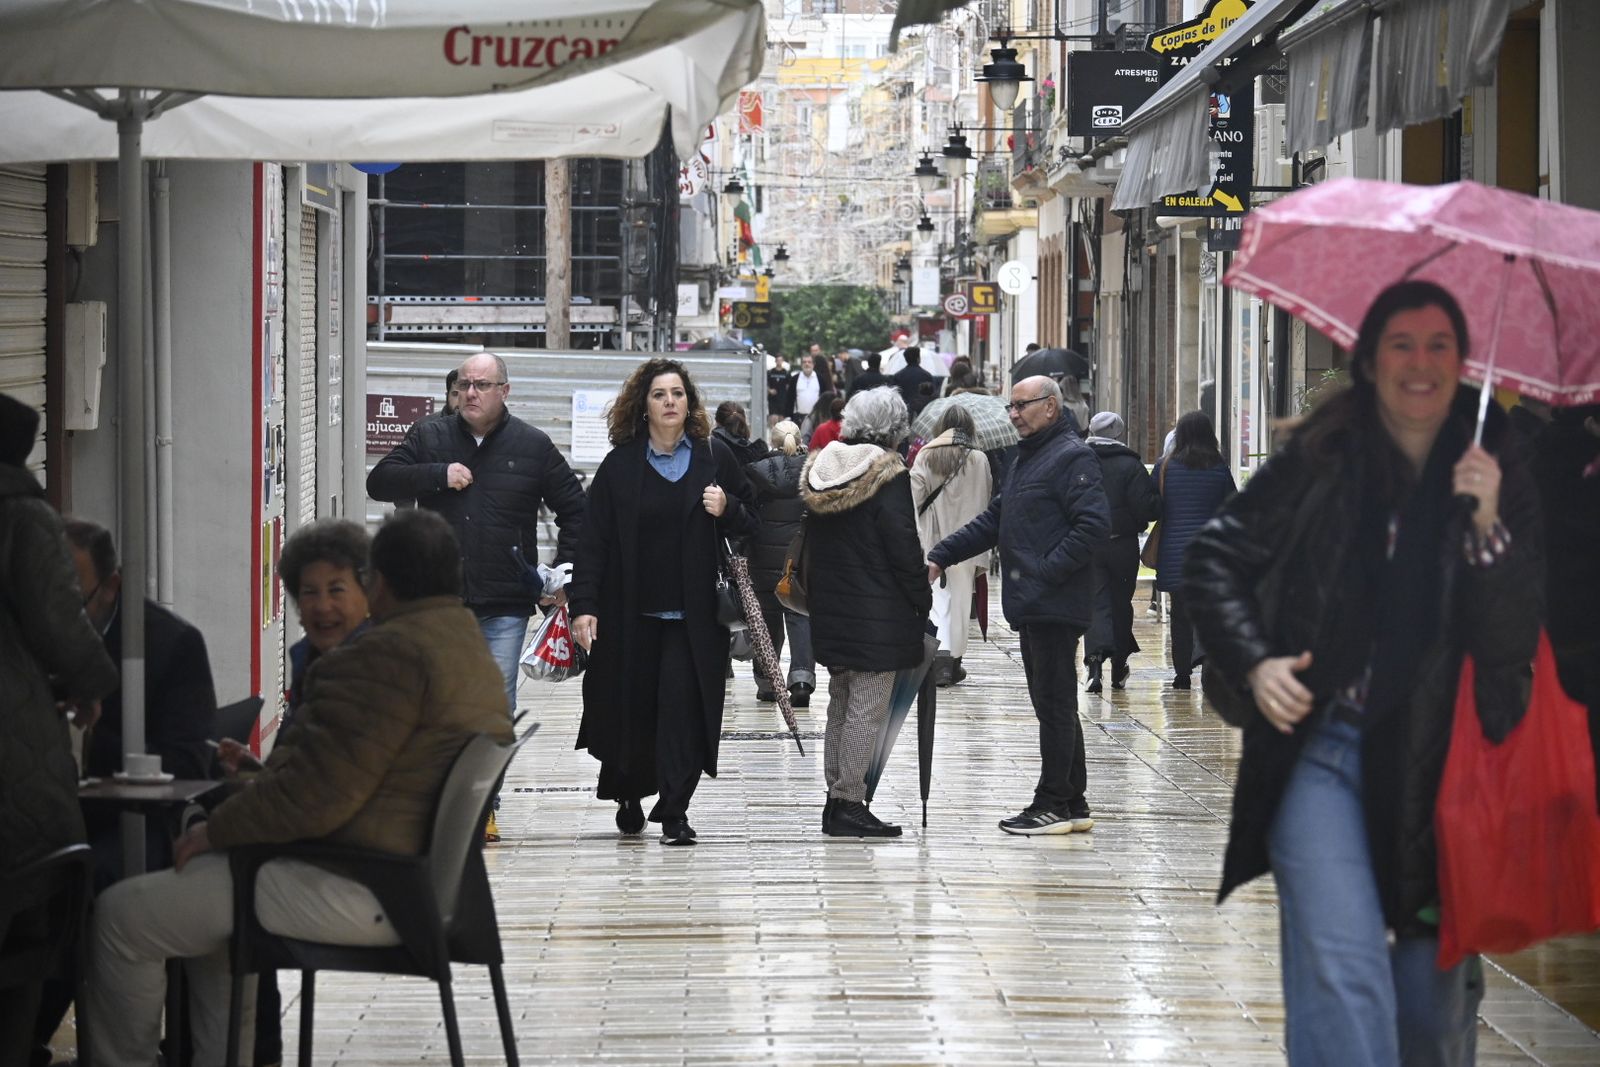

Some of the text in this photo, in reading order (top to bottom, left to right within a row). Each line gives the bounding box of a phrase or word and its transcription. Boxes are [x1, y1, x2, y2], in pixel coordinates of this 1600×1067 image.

[1160, 29, 1198, 48] Copias
[1202, 22, 1216, 35] de
[1220, 16, 1238, 30] lla
[1219, 173, 1234, 183] piel
[1165, 197, 1176, 206] EN
